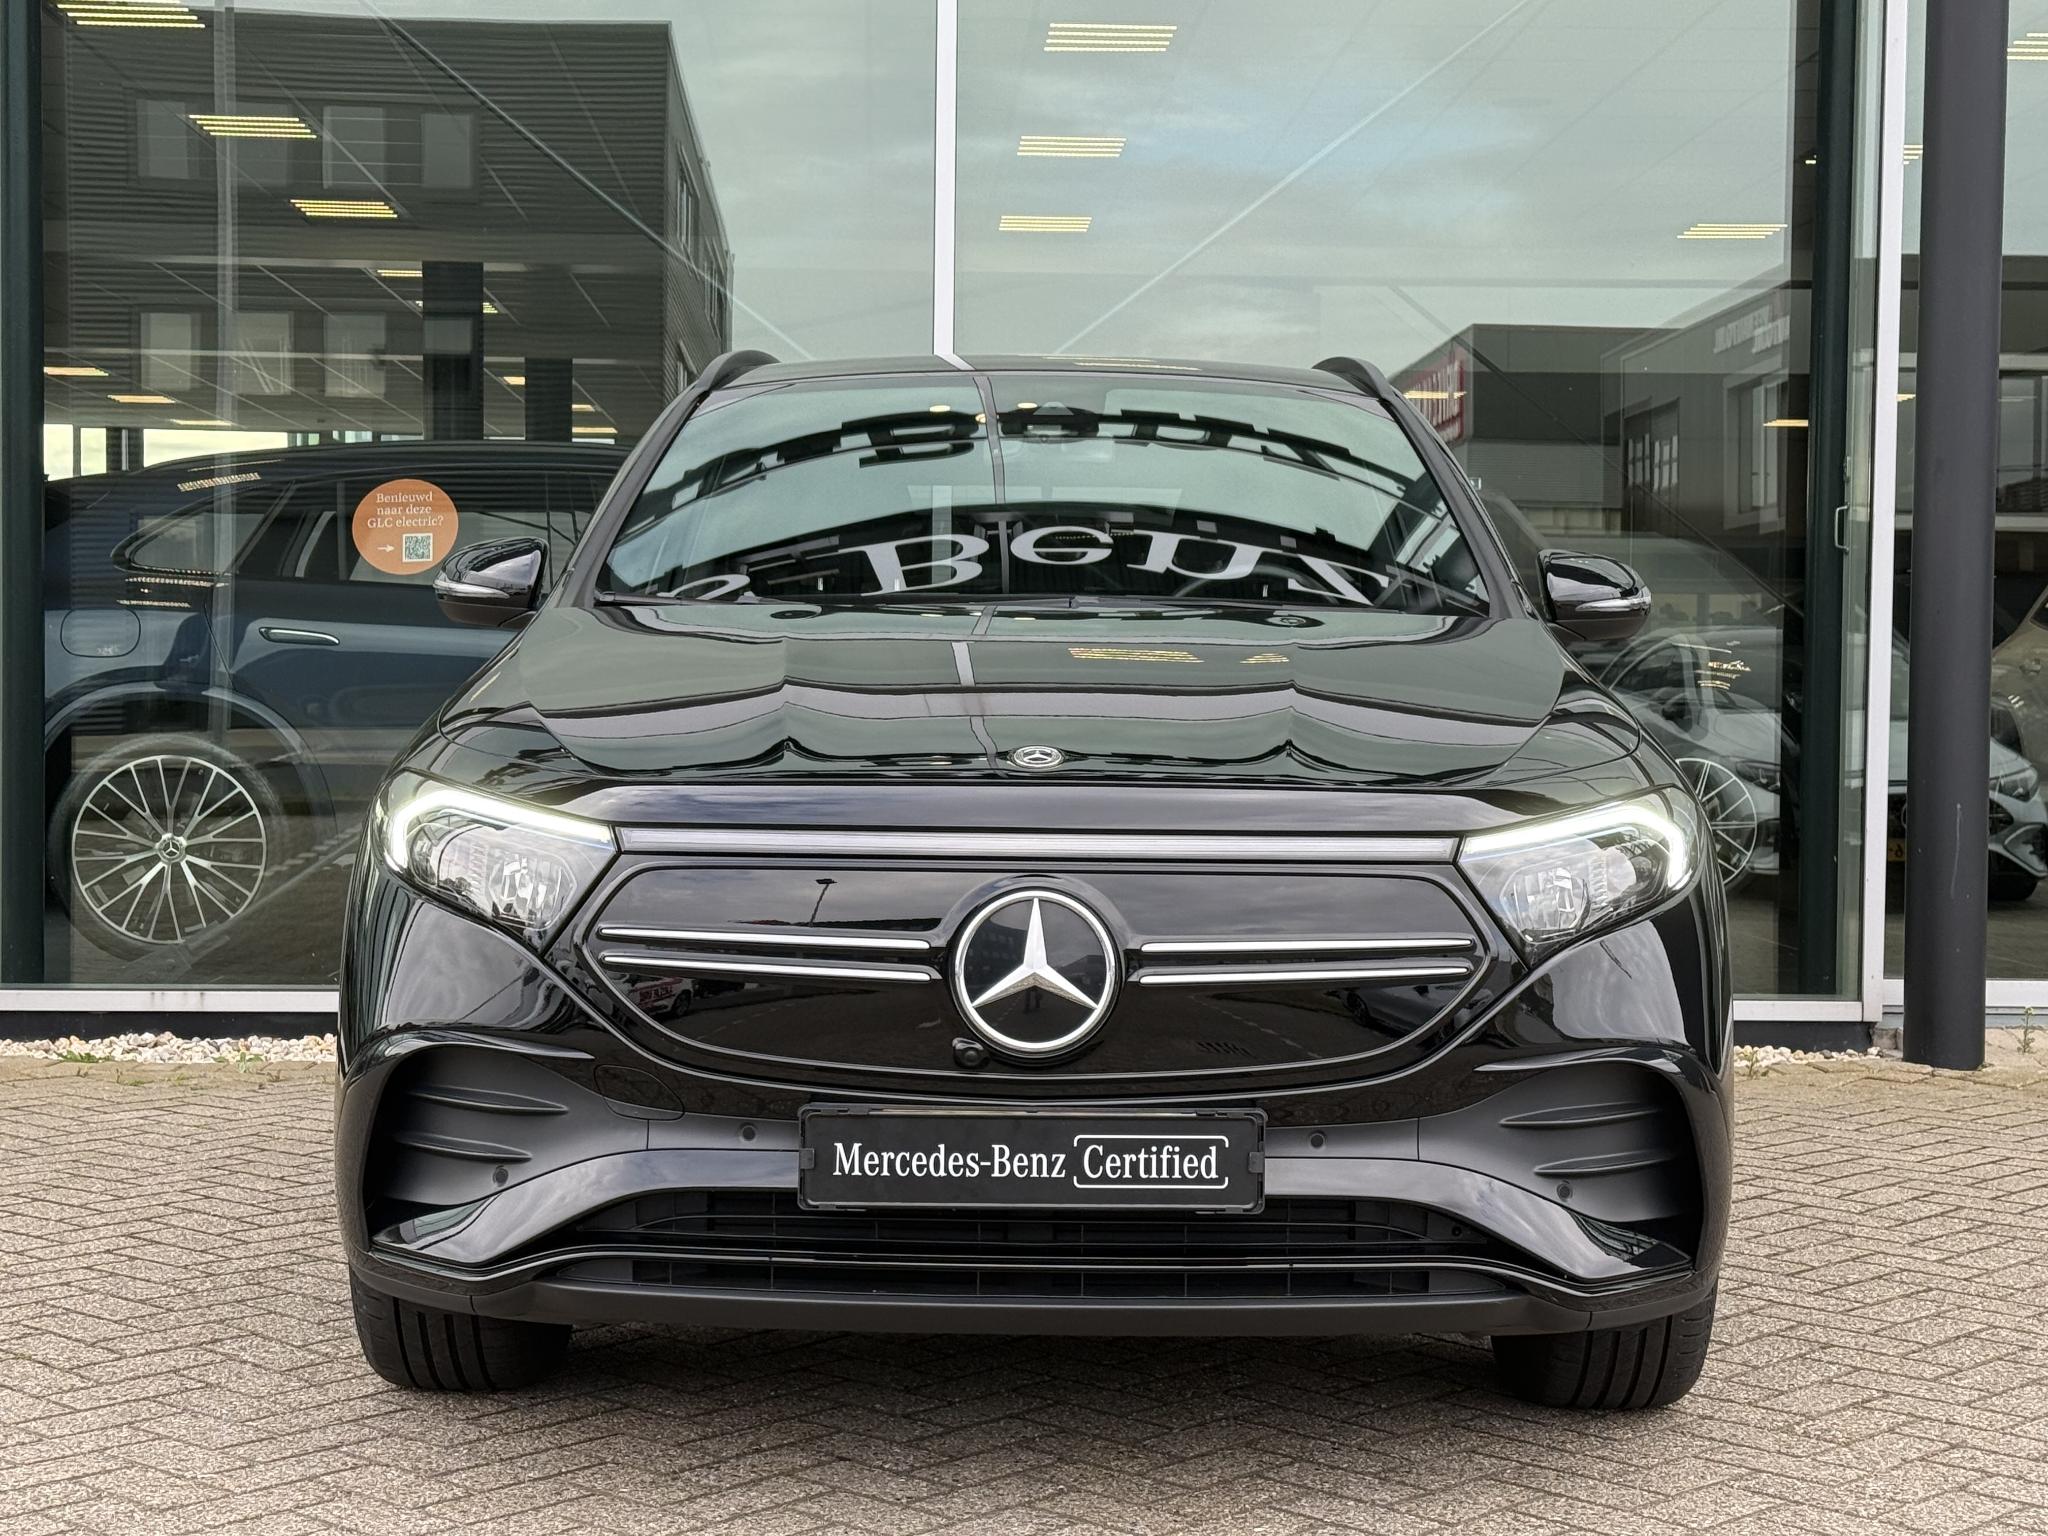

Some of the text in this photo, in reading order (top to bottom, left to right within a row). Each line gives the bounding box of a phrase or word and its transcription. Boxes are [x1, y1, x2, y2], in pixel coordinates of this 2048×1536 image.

[376, 491, 433, 503] Benieuwd
[377, 504, 432, 516] naar deze
[367, 515, 444, 529] GLC electric?
[833, 1142, 1219, 1180] Mercedes-Benz Certified
